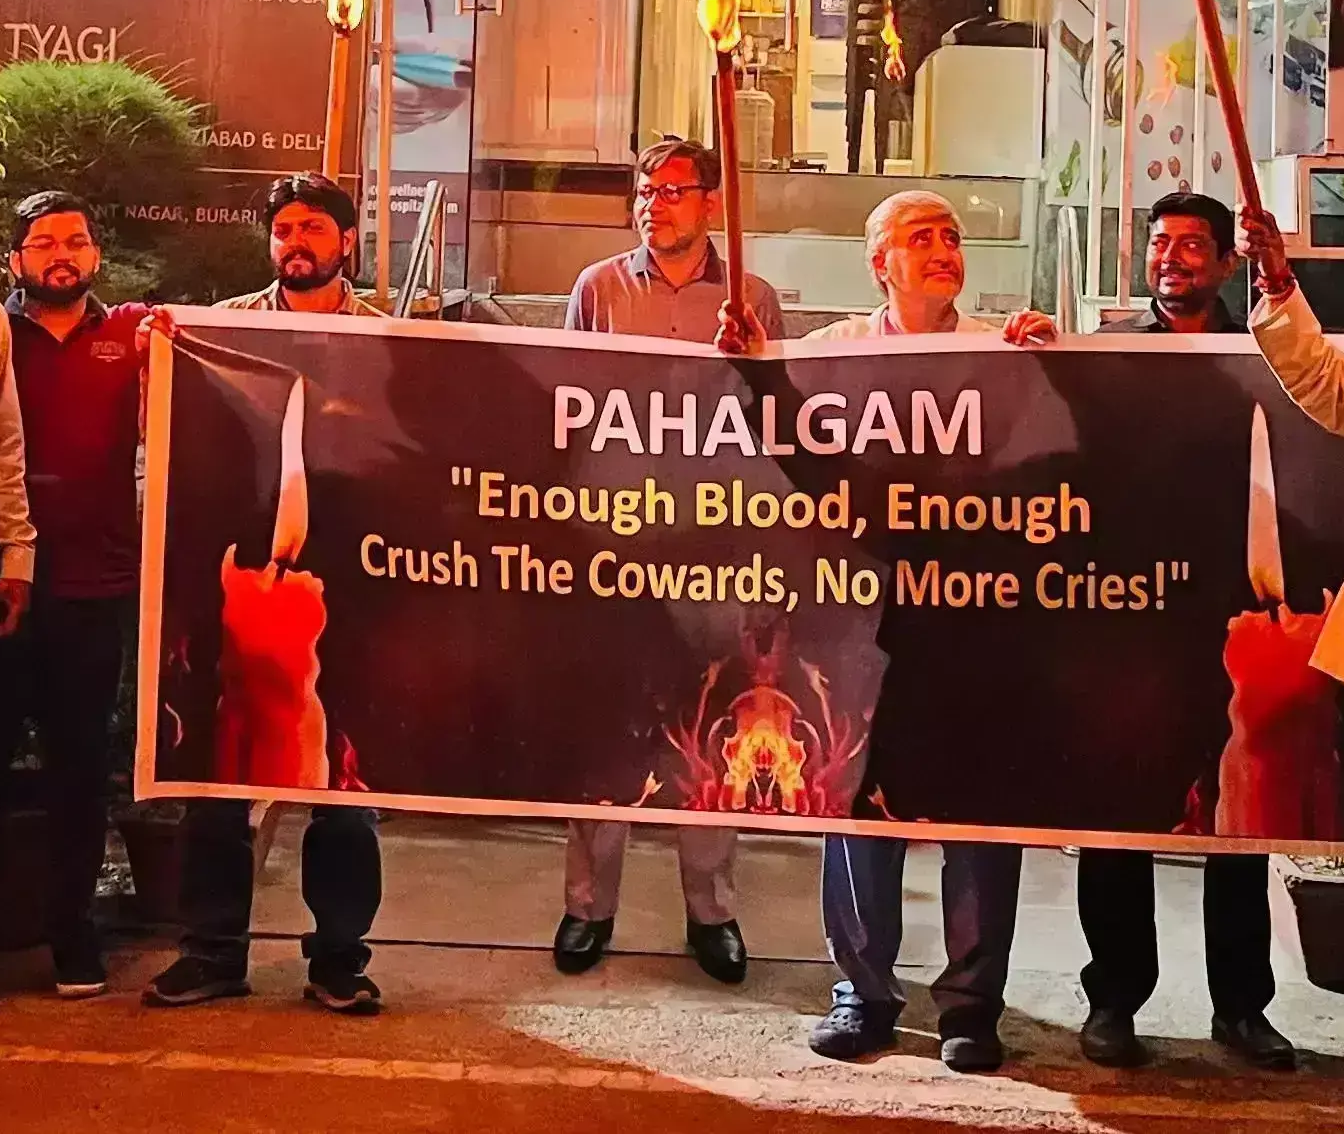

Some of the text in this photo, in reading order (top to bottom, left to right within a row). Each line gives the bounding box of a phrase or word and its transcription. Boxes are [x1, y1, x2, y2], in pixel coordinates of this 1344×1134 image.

[4, 22, 117, 64] TYAGI
[262, 133, 277, 150] &
[125, 204, 256, 225] NAGAR, BURARI
[552, 385, 984, 457] PAHALGAM
[451, 466, 1092, 545] "Enough Blood, Enough
[359, 532, 1190, 612] Crush The Cowards, No More Cries!"
